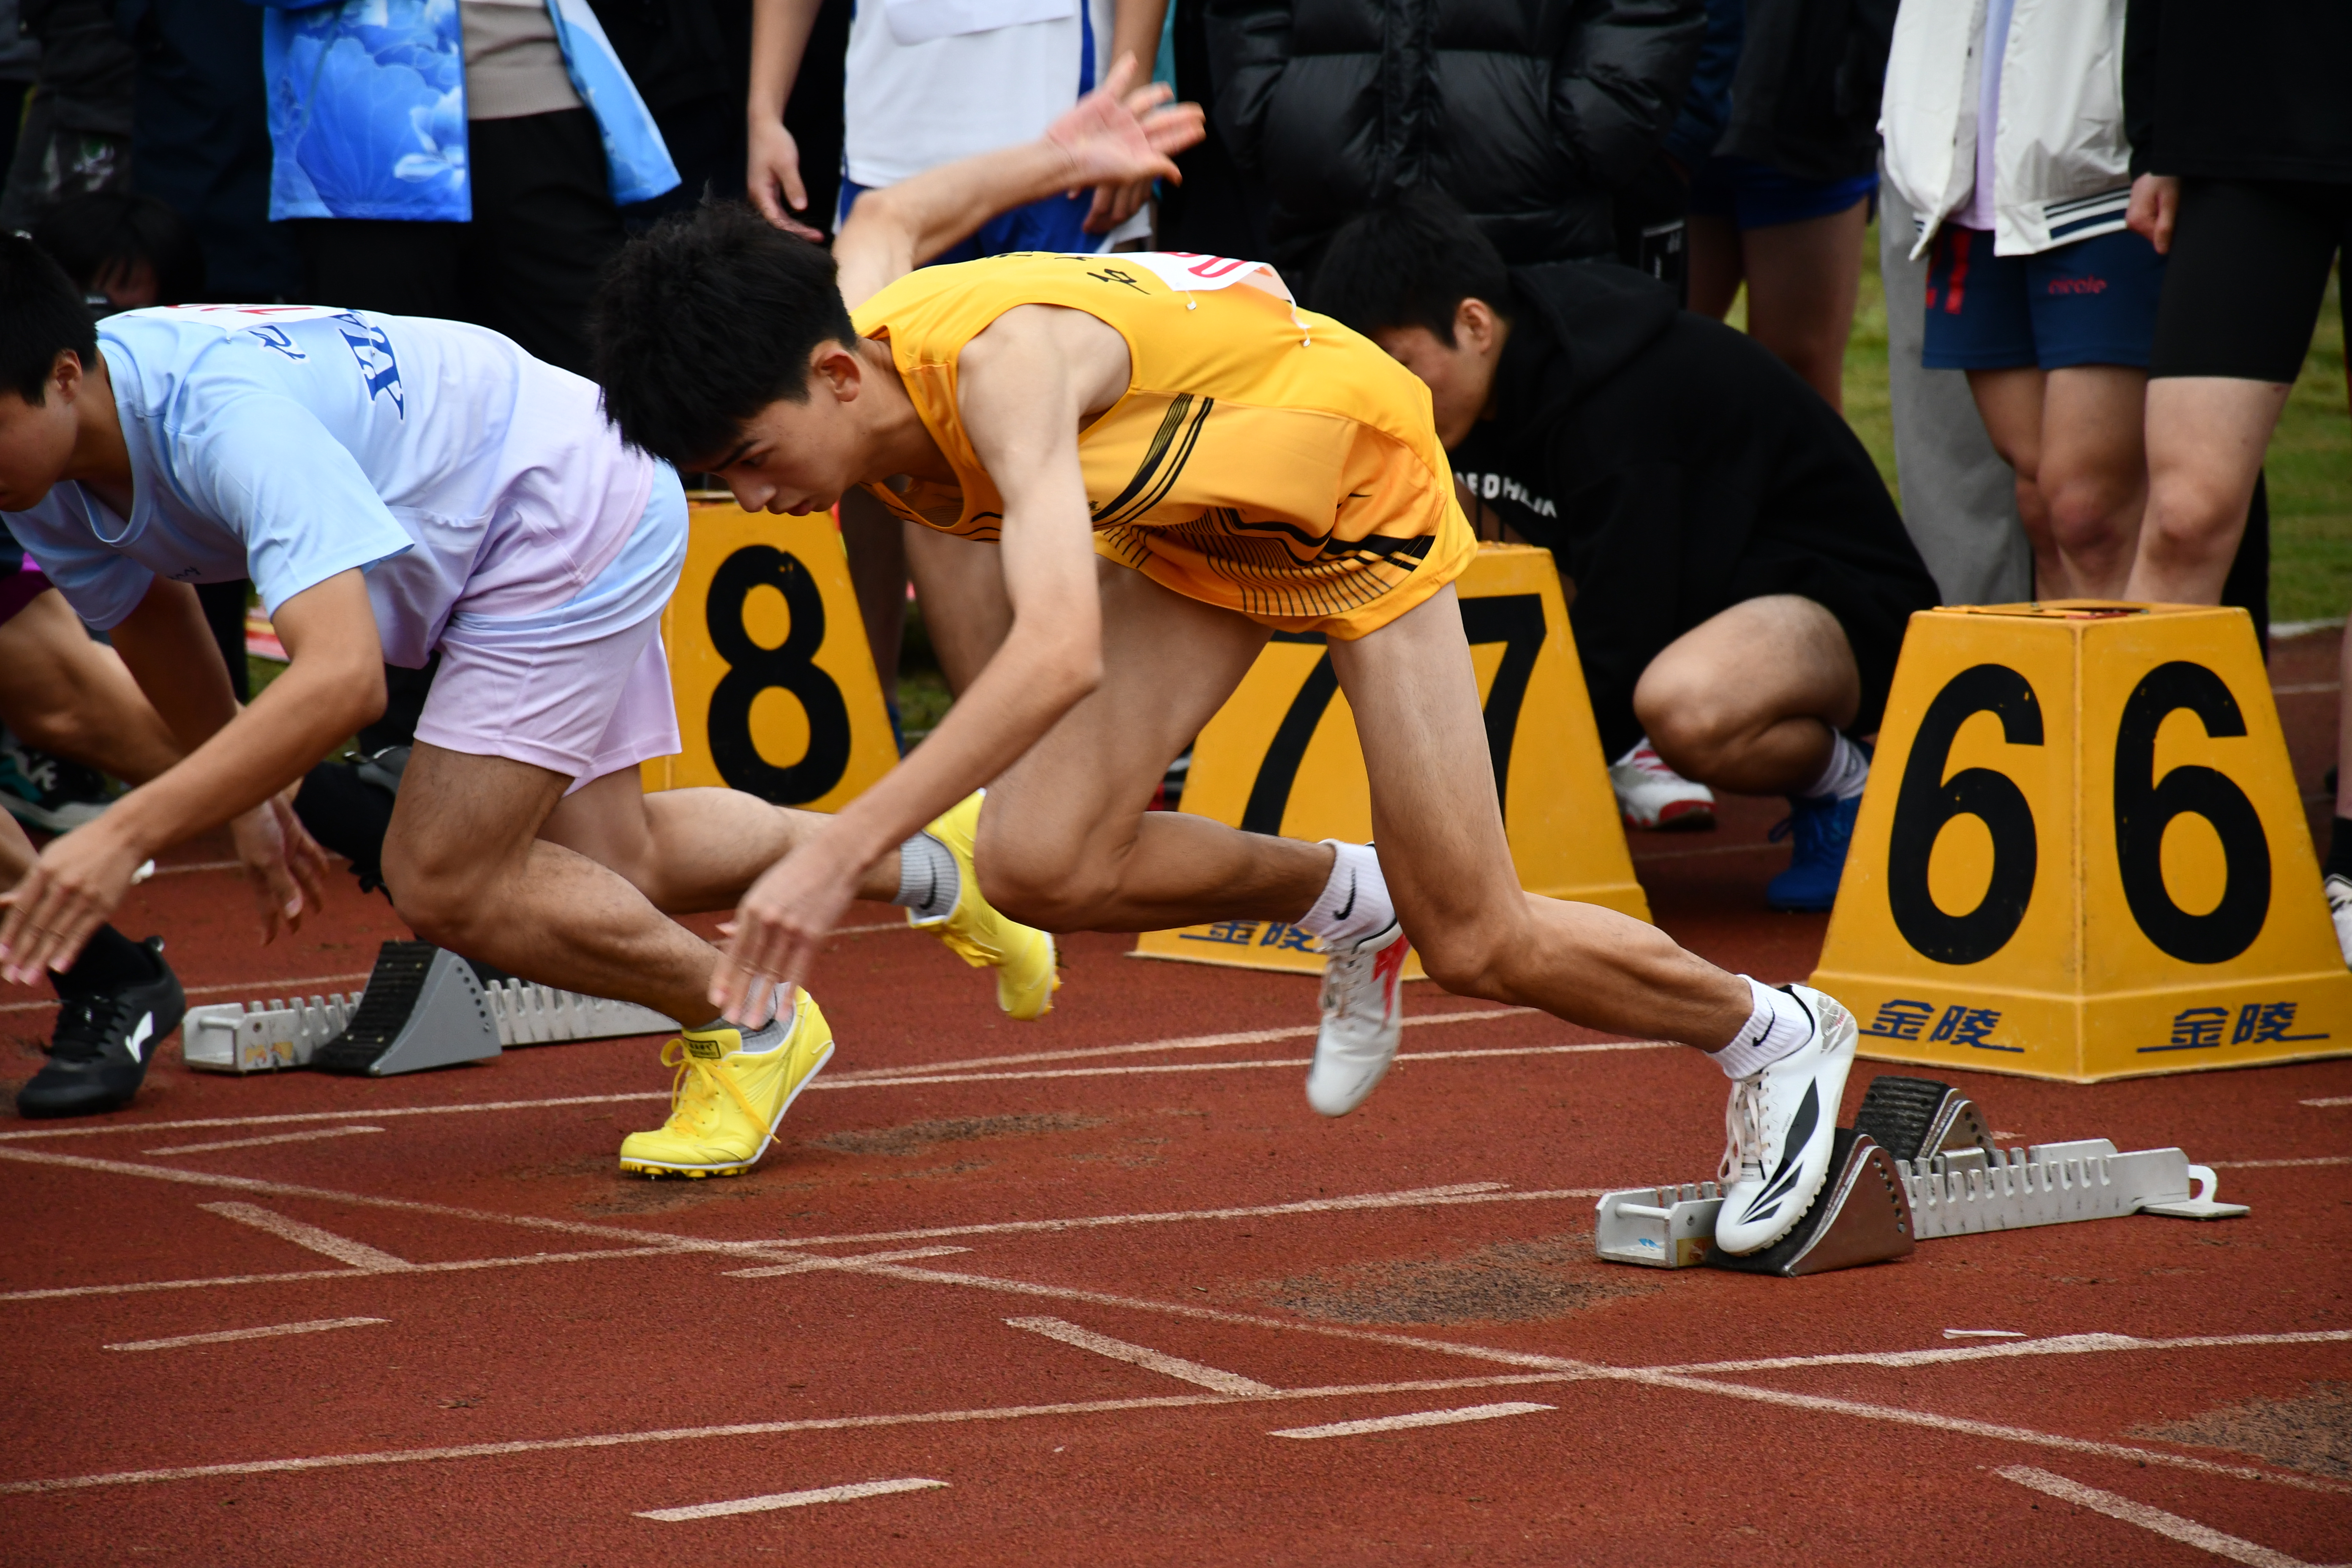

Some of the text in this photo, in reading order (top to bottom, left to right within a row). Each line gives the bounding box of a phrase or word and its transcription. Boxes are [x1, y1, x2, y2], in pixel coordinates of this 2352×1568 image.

[706, 544, 851, 805] 8
[1887, 663, 2044, 965] 6
[2114, 661, 2272, 964] 6
[1859, 999, 2025, 1053] 金陵
[2137, 1002, 2330, 1053] 金陵
